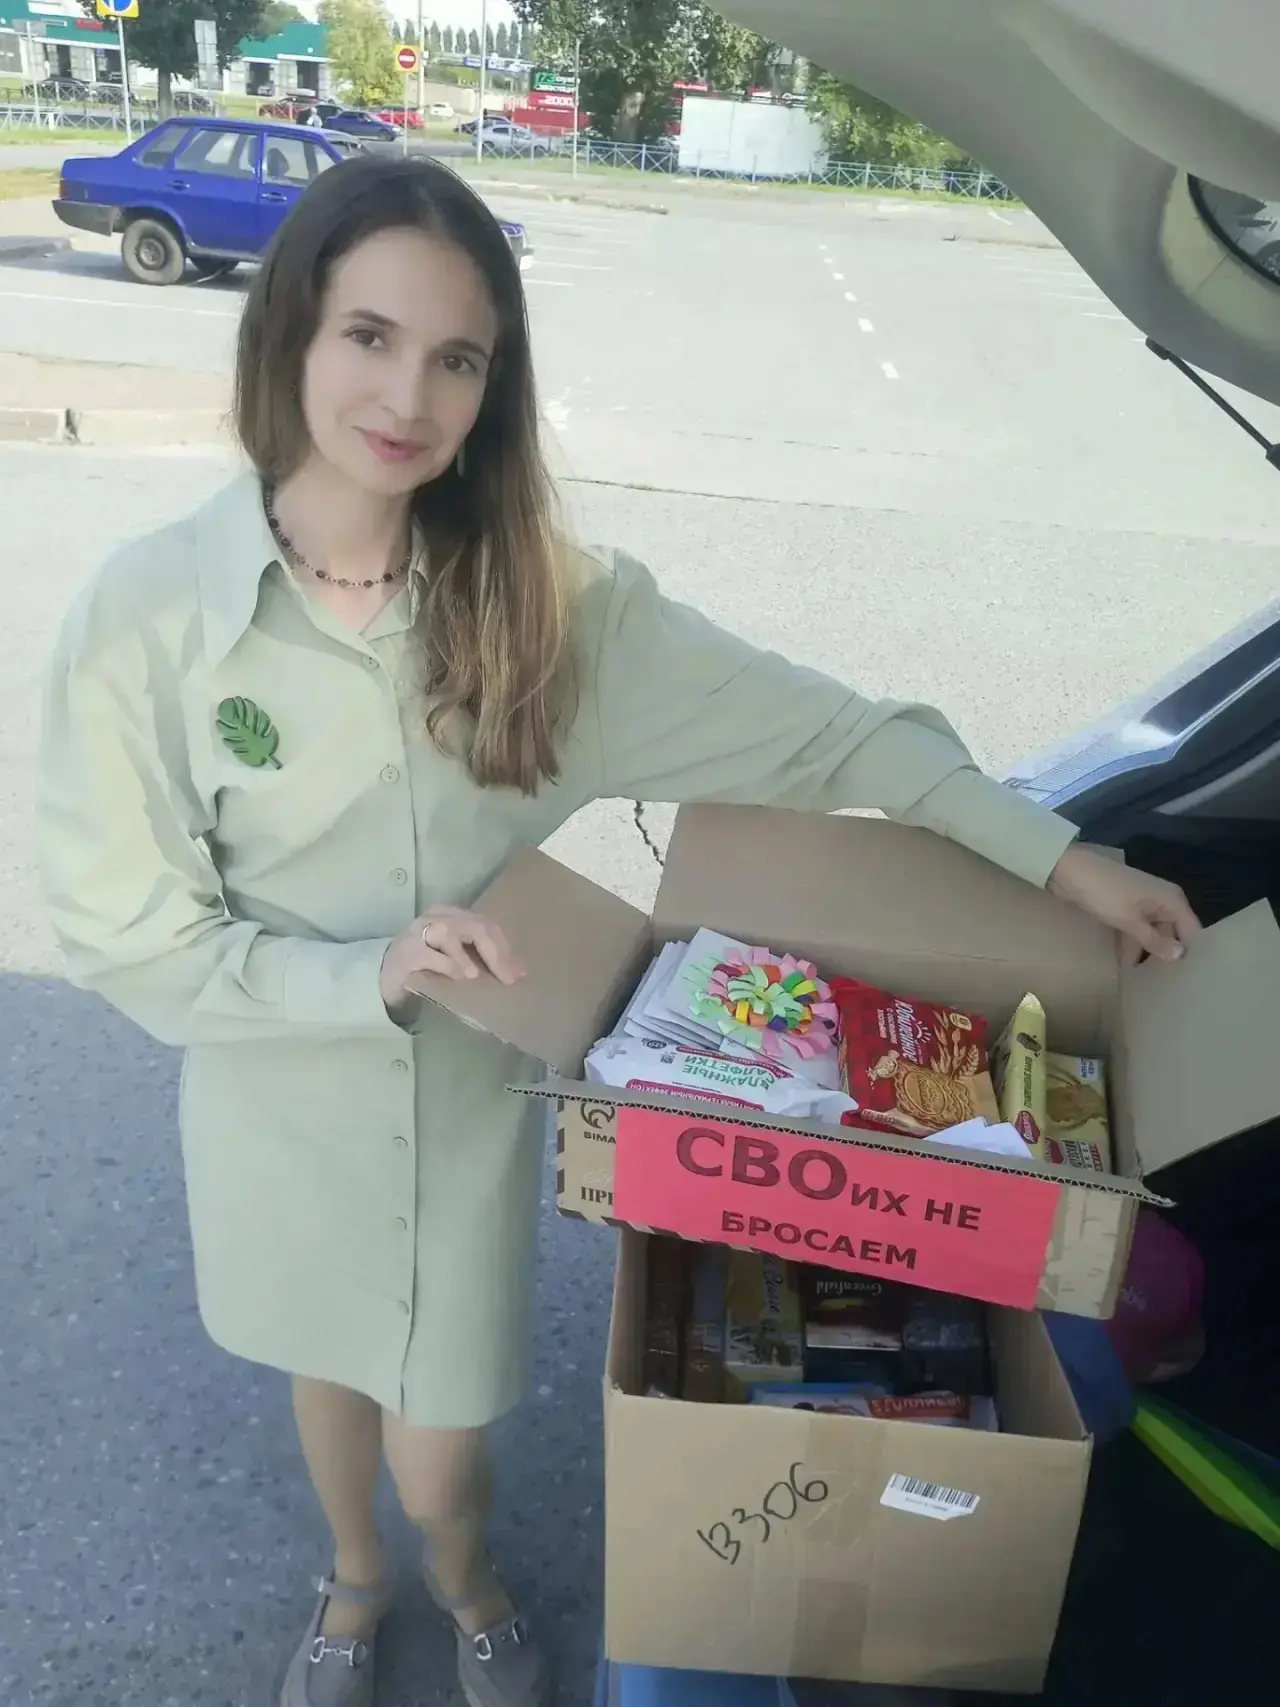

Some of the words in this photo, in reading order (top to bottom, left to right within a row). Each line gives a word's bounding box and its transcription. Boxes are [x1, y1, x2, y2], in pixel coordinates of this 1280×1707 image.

[894, 999, 918, 1064] Юбилейное
[684, 1055, 775, 1084] САЛФЕТКИ
[924, 1199, 982, 1231] НЕ
[721, 1210, 917, 1270] БРОСАЕМ
[816, 1279, 882, 1296] Greenfield
